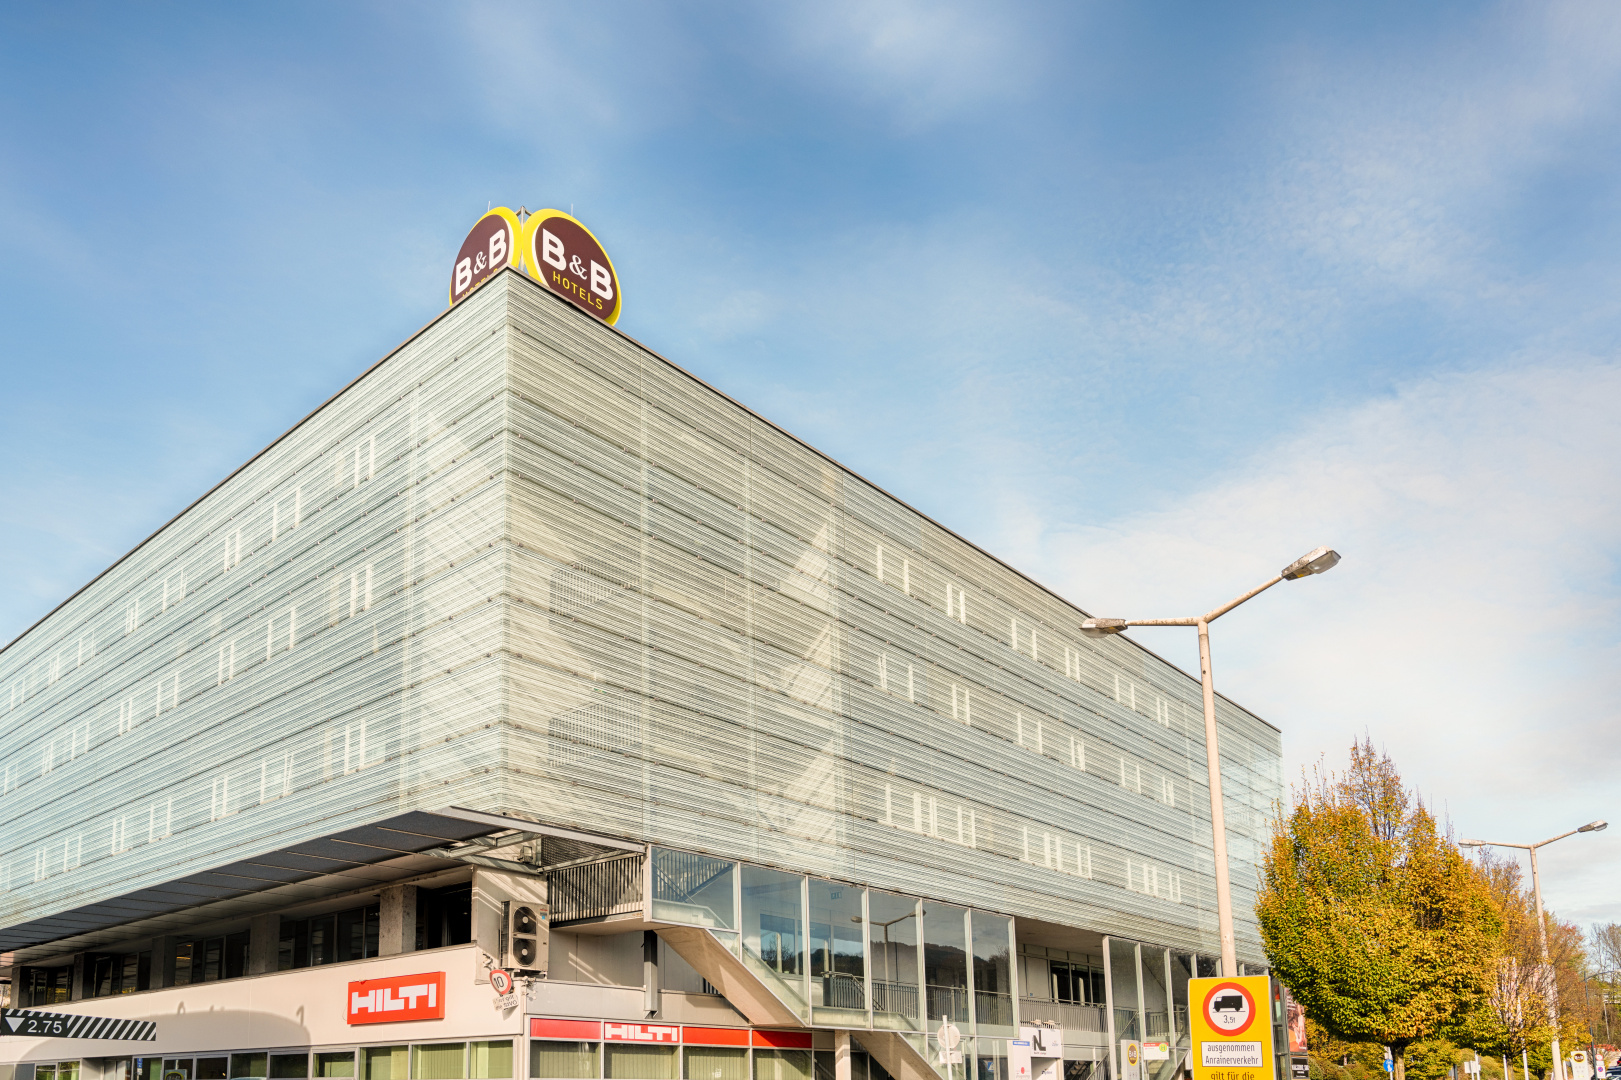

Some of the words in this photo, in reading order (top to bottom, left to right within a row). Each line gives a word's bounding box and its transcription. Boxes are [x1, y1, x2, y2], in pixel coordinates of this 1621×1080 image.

[455, 228, 507, 296] B&B
[542, 228, 614, 301] B&B
[552, 270, 603, 311] HOTELS
[494, 976, 504, 988] 10
[351, 983, 437, 1015] HILTI
[27, 1019, 63, 1034] 2.75
[1223, 1015, 1236, 1024] 3,5t
[604, 1023, 679, 1041] HILTI
[1207, 1044, 1255, 1053] ausgenommen
[1205, 1055, 1259, 1065] Anrainerverkehr
[1210, 1071, 1225, 1080] gilt
[1227, 1071, 1239, 1080] für
[1242, 1071, 1255, 1080] die
